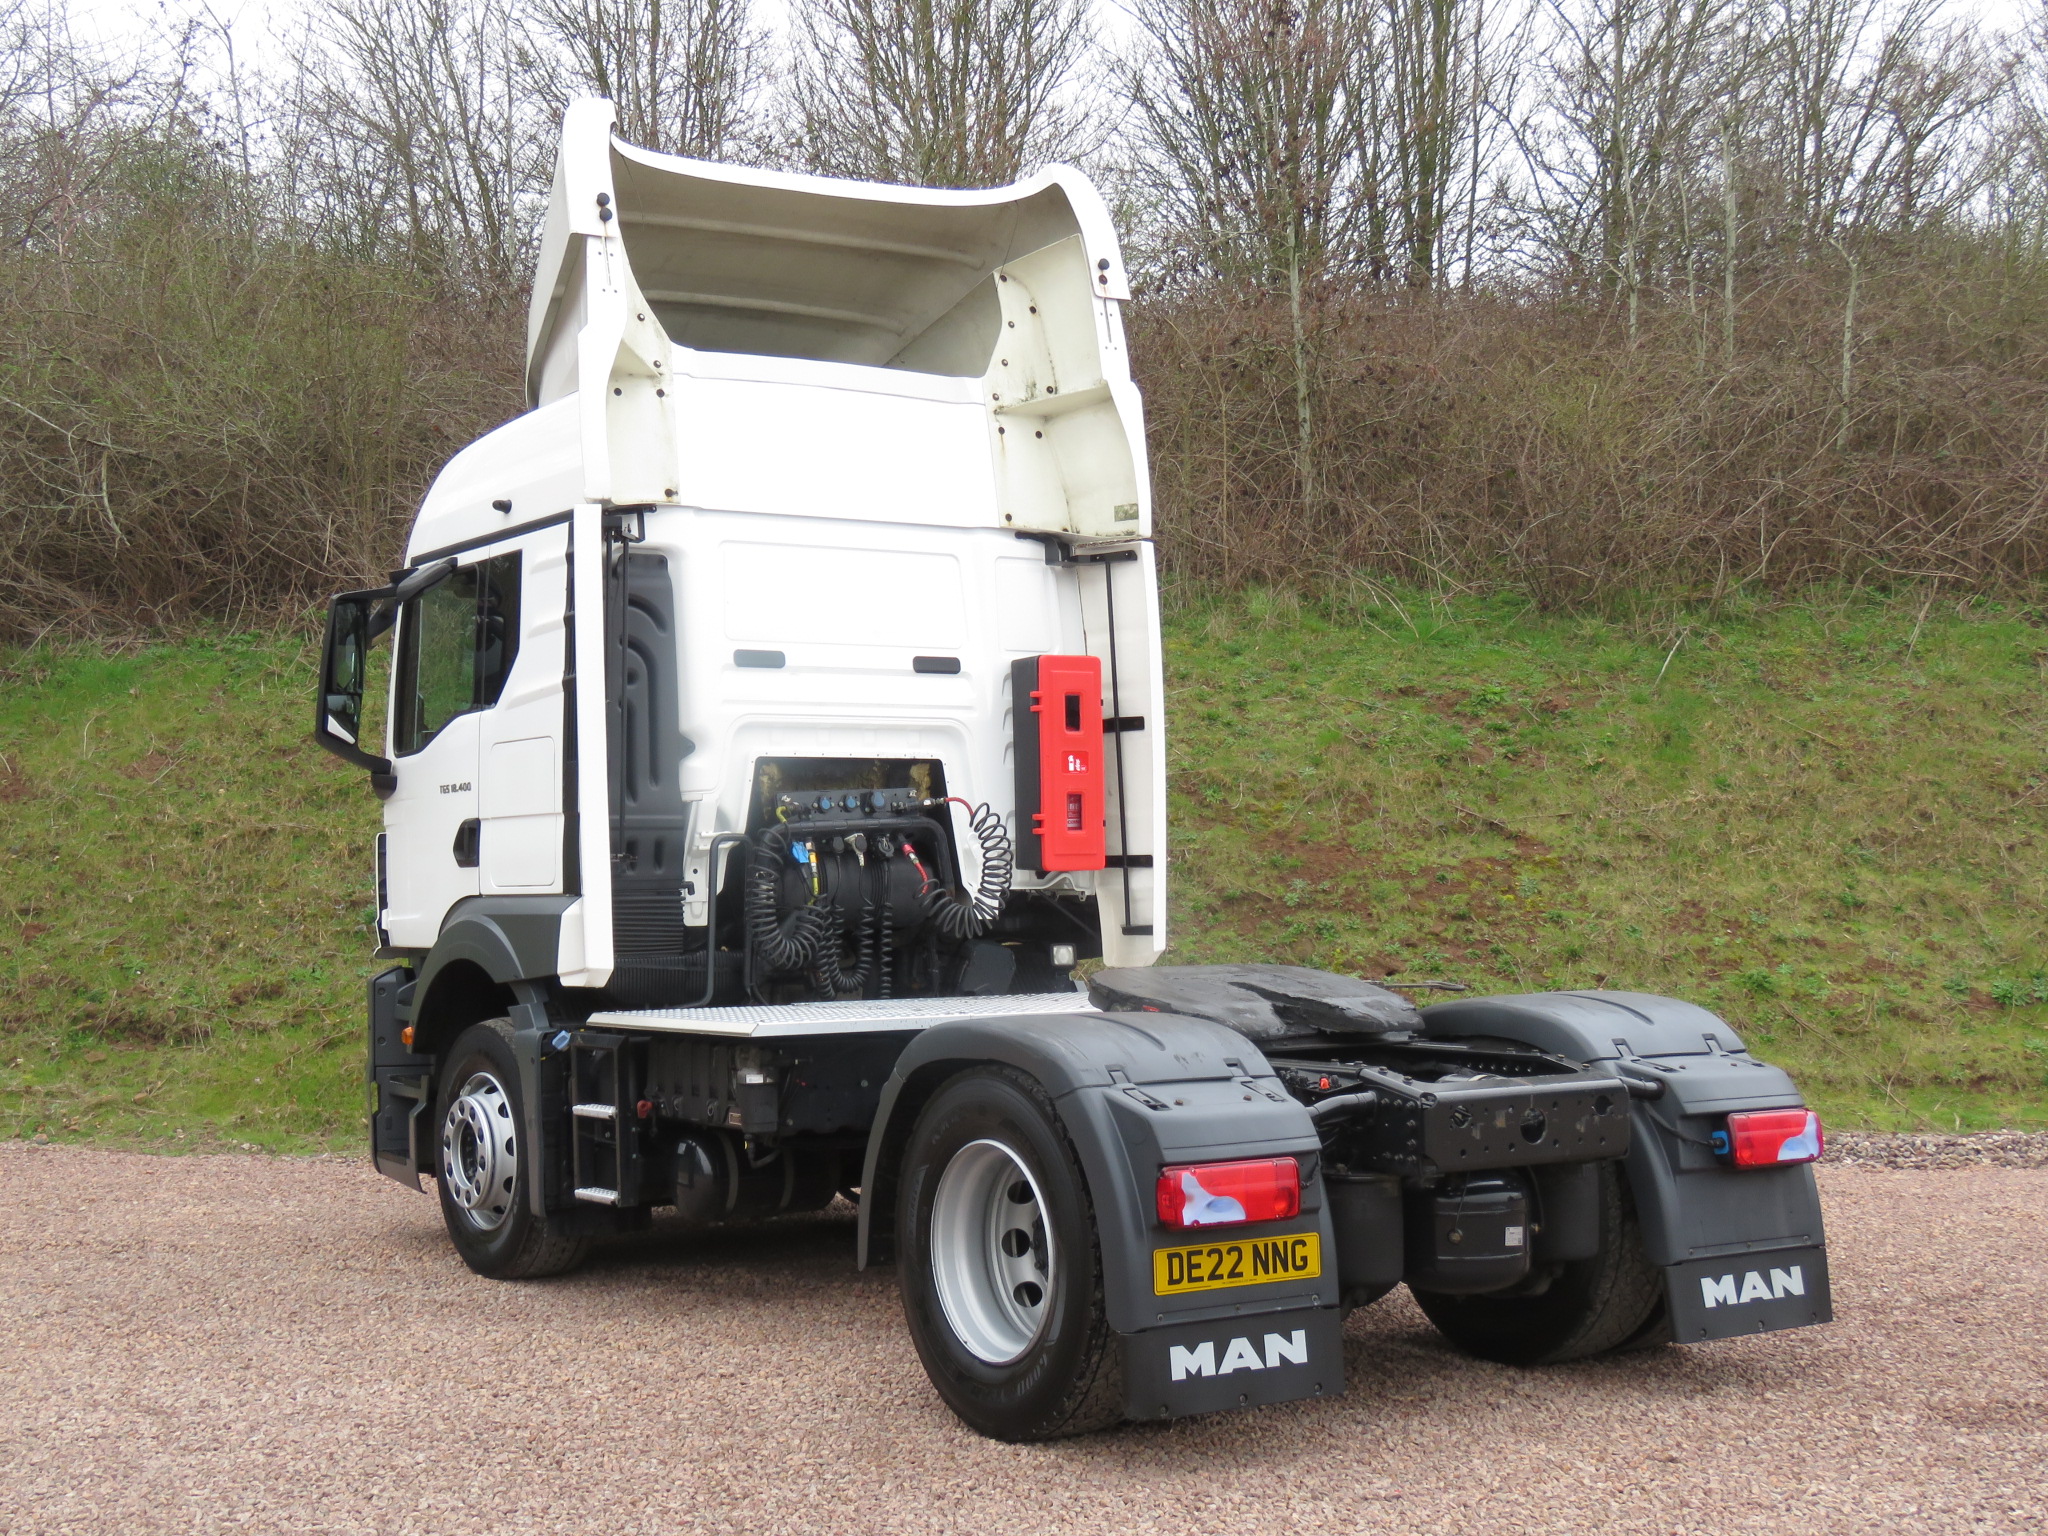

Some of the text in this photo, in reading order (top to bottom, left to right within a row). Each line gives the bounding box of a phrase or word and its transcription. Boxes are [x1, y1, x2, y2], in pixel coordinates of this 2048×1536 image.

[439, 782, 472, 795] TGS 18.400
[1166, 1239, 1308, 1286] DE22 NNG
[1700, 1265, 1805, 1308] MAN
[1169, 1329, 1308, 1381] MAN
